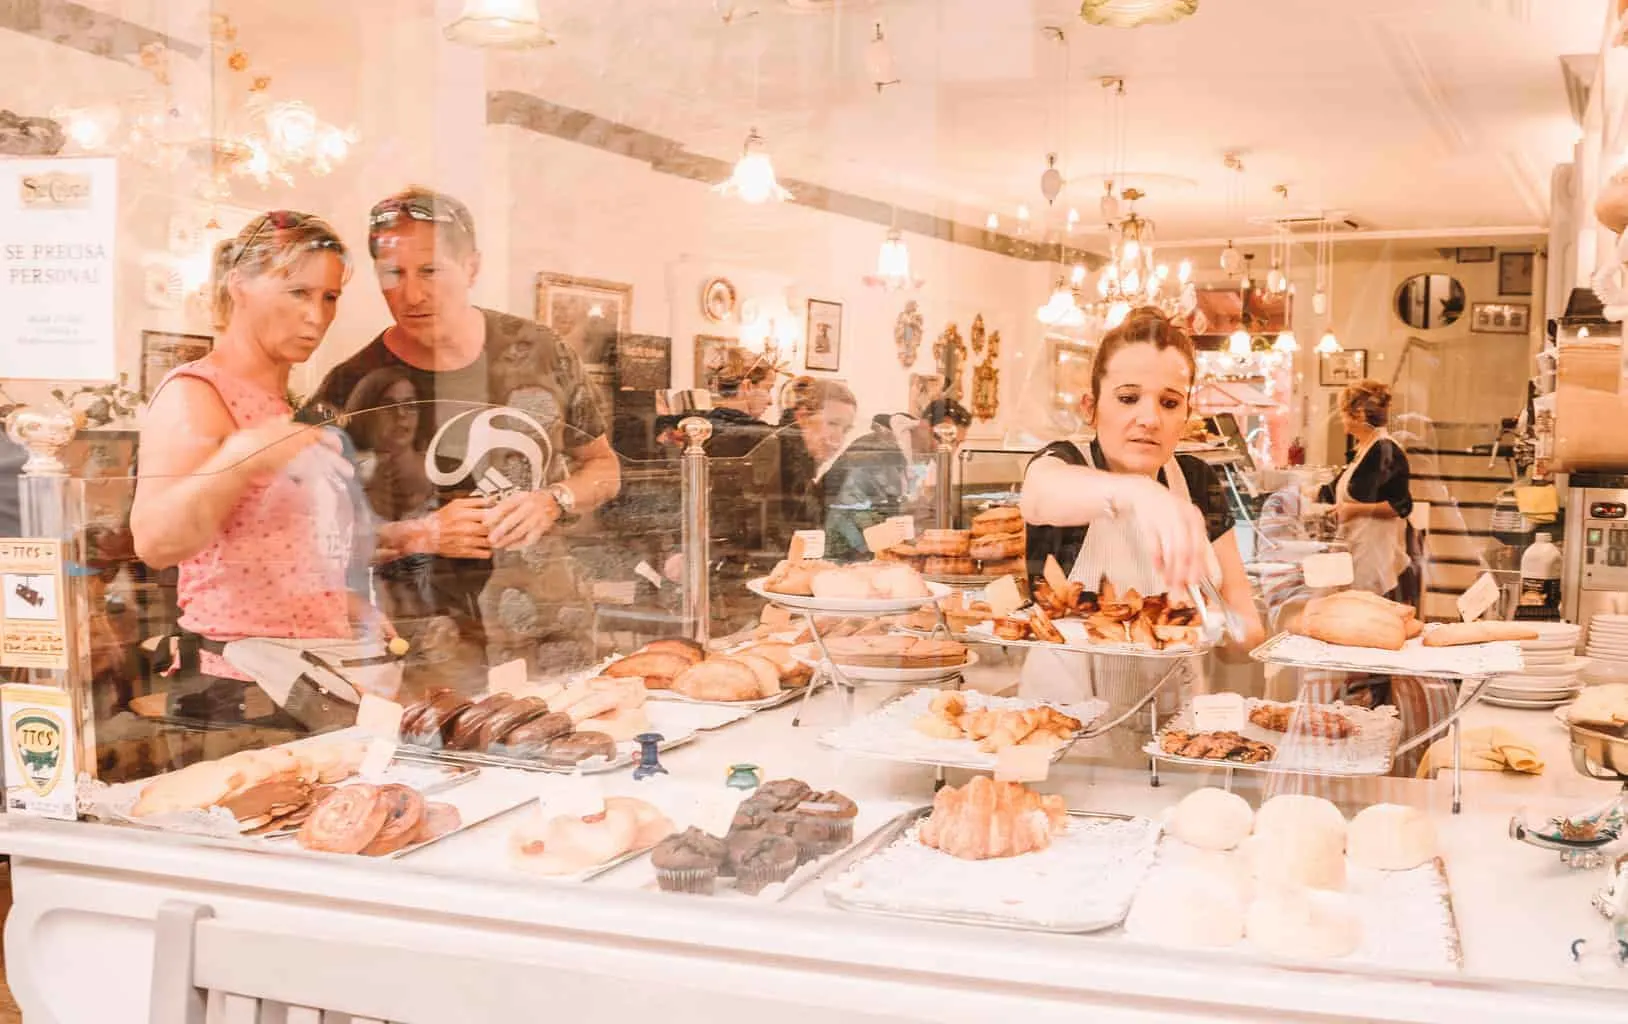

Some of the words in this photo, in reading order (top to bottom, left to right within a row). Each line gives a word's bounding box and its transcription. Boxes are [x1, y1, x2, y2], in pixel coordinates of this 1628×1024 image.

[6, 244, 25, 260] SE
[32, 244, 106, 260] PRECISA
[9, 267, 101, 284] PERSONAL
[23, 729, 54, 746] TTCS
